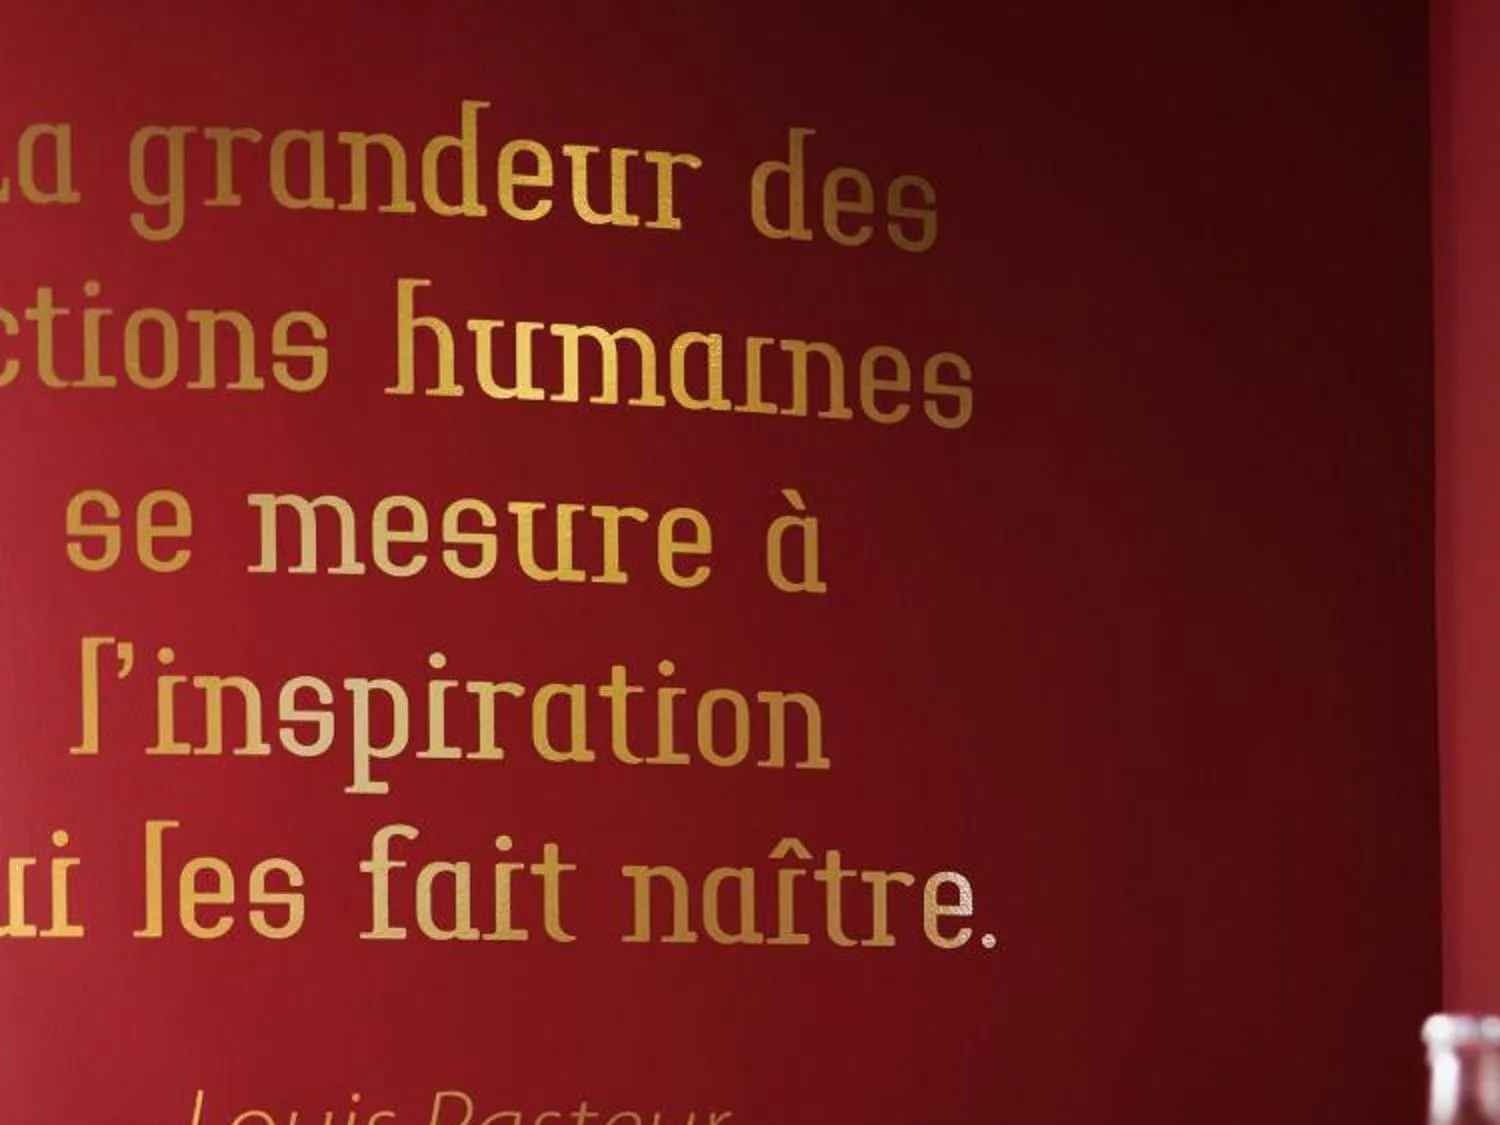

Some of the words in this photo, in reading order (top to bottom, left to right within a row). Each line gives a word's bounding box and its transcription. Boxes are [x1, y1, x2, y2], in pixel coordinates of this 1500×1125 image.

[0, 124, 82, 205] a
[129, 100, 703, 242] grandeur
[751, 127, 938, 253] des
[66, 489, 193, 573] se
[248, 492, 713, 588] mesure
[767, 488, 827, 593] à
[69, 636, 831, 795] l'inspiration
[133, 819, 306, 940] les
[360, 823, 577, 943] fait
[622, 837, 997, 949] naître.
